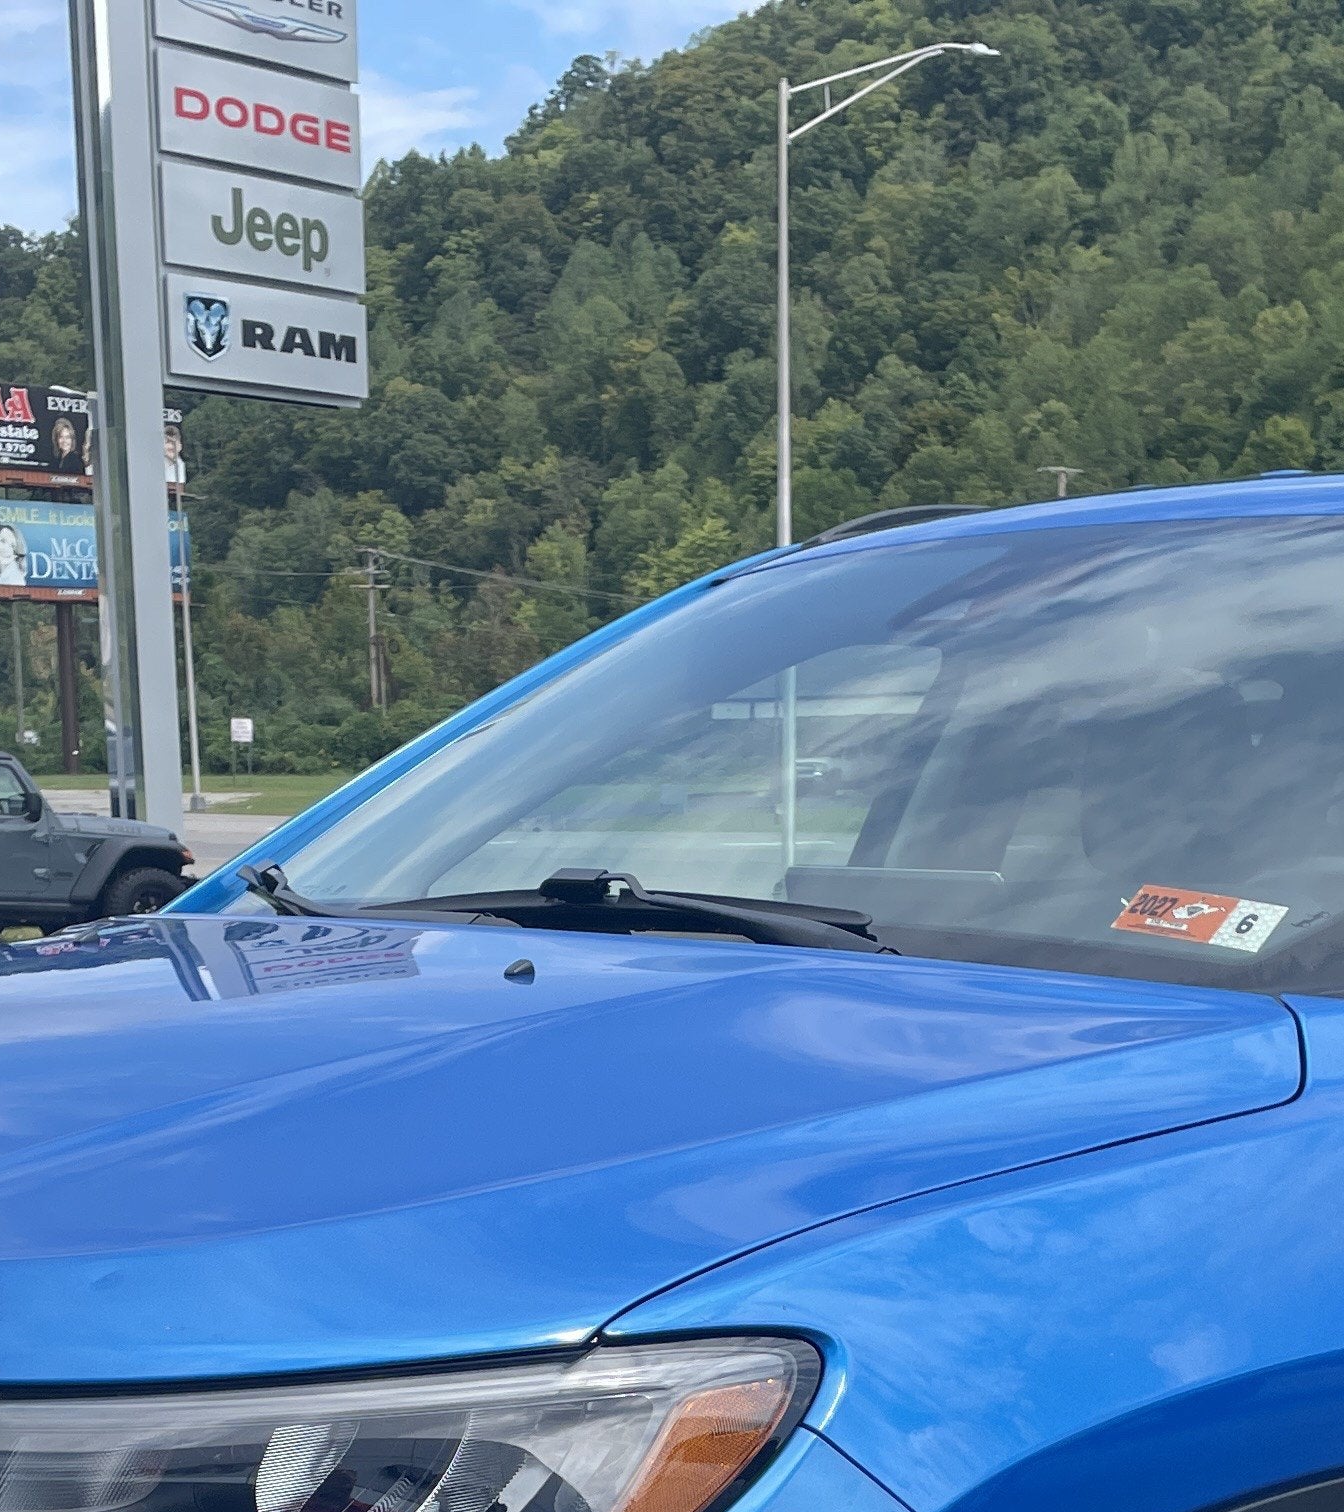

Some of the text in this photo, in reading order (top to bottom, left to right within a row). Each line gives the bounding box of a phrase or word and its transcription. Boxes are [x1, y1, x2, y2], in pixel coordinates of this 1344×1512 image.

[173, 86, 352, 154] DODGE
[211, 187, 329, 273] Jeep
[241, 319, 357, 364] RAM
[1128, 893, 1179, 918] 2027
[1235, 913, 1259, 934] 6
